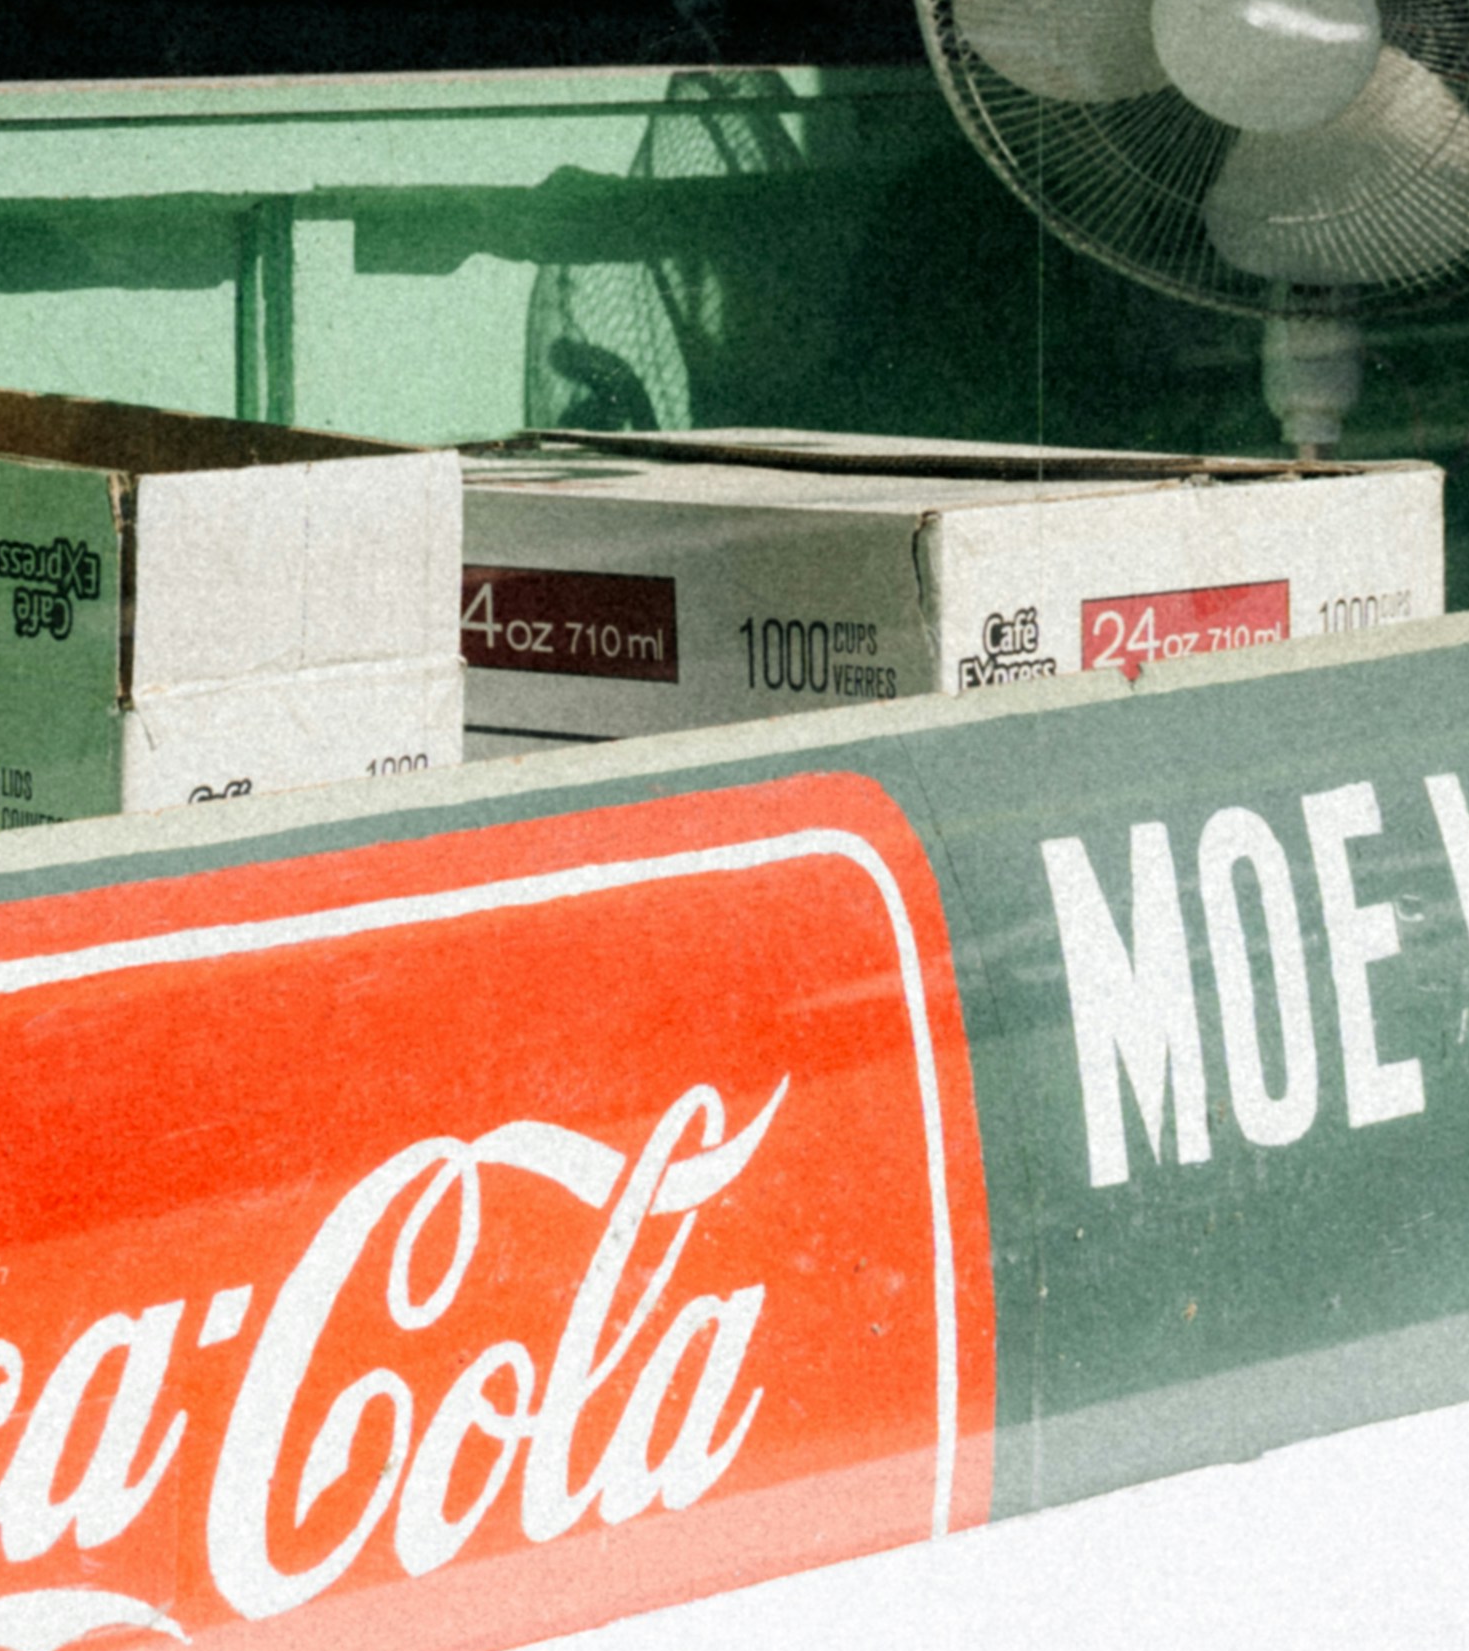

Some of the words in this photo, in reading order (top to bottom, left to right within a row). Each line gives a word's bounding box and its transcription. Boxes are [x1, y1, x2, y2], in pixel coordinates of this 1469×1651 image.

[13, 586, 73, 641] Café
[985, 607, 1039, 657] Café
[565, 622, 621, 658] 710
[627, 628, 664, 661] ml
[739, 617, 830, 693] 1000
[833, 621, 878, 657] CUPS
[1207, 623, 1250, 653] 710
[833, 663, 897, 700] VERRES
[1, 767, 33, 801] LIDS
[1040, 779, 1427, 1189] MOE
